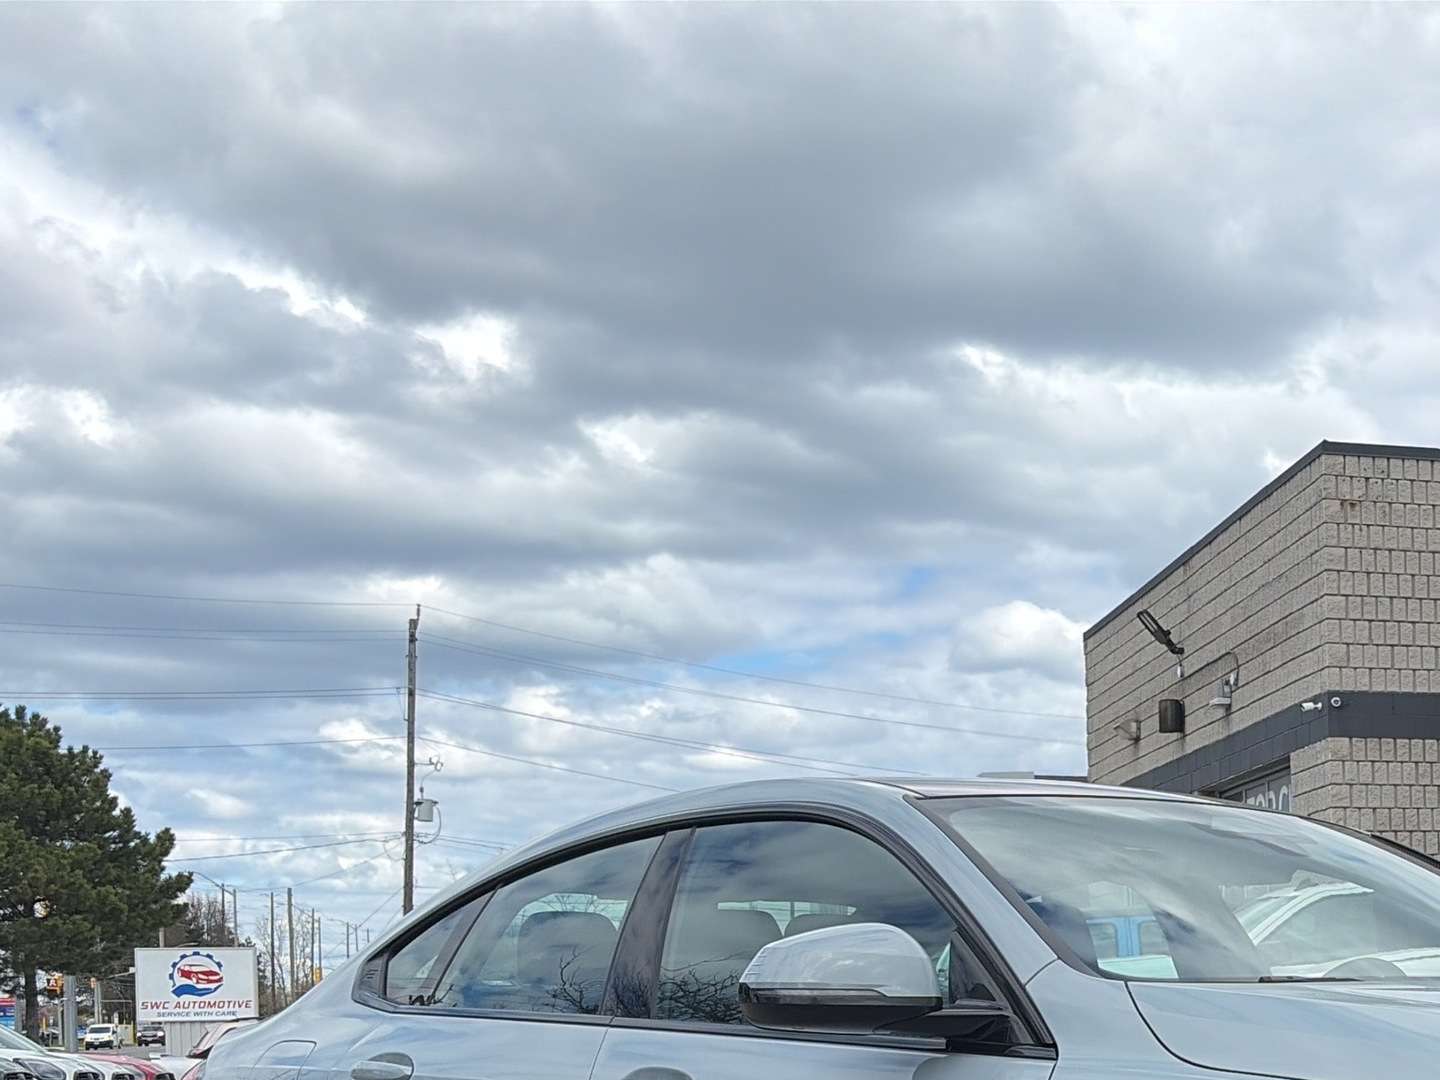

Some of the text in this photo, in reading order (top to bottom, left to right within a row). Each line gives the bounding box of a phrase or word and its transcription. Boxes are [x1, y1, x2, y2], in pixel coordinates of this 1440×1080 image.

[140, 1000, 252, 1010] SWC AUTOMOTIVE
[193, 1010, 213, 1018] WITH
